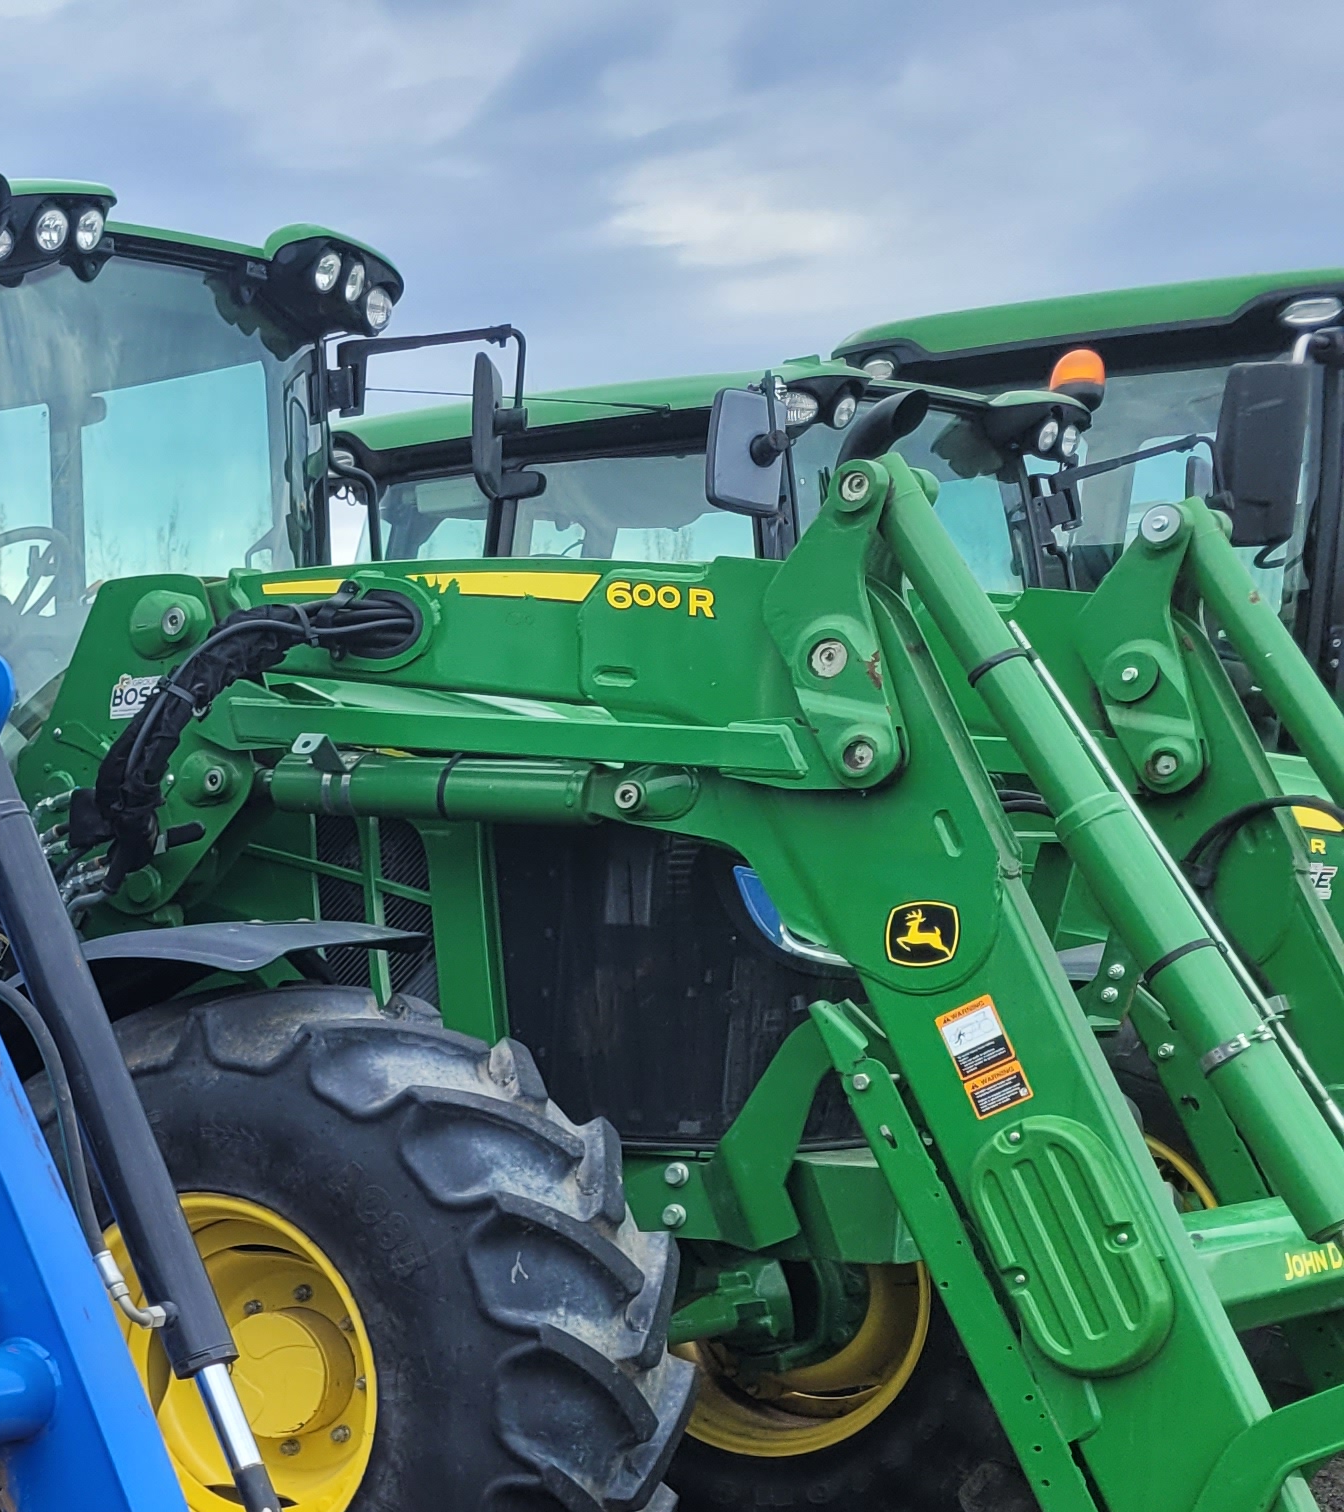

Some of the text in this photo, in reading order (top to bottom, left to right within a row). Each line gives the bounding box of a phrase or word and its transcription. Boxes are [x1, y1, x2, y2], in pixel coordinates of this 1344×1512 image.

[950, 1000, 985, 1021] WARNING
[980, 1066, 1015, 1086] WARNING
[1284, 1249, 1329, 1281] JOHN
